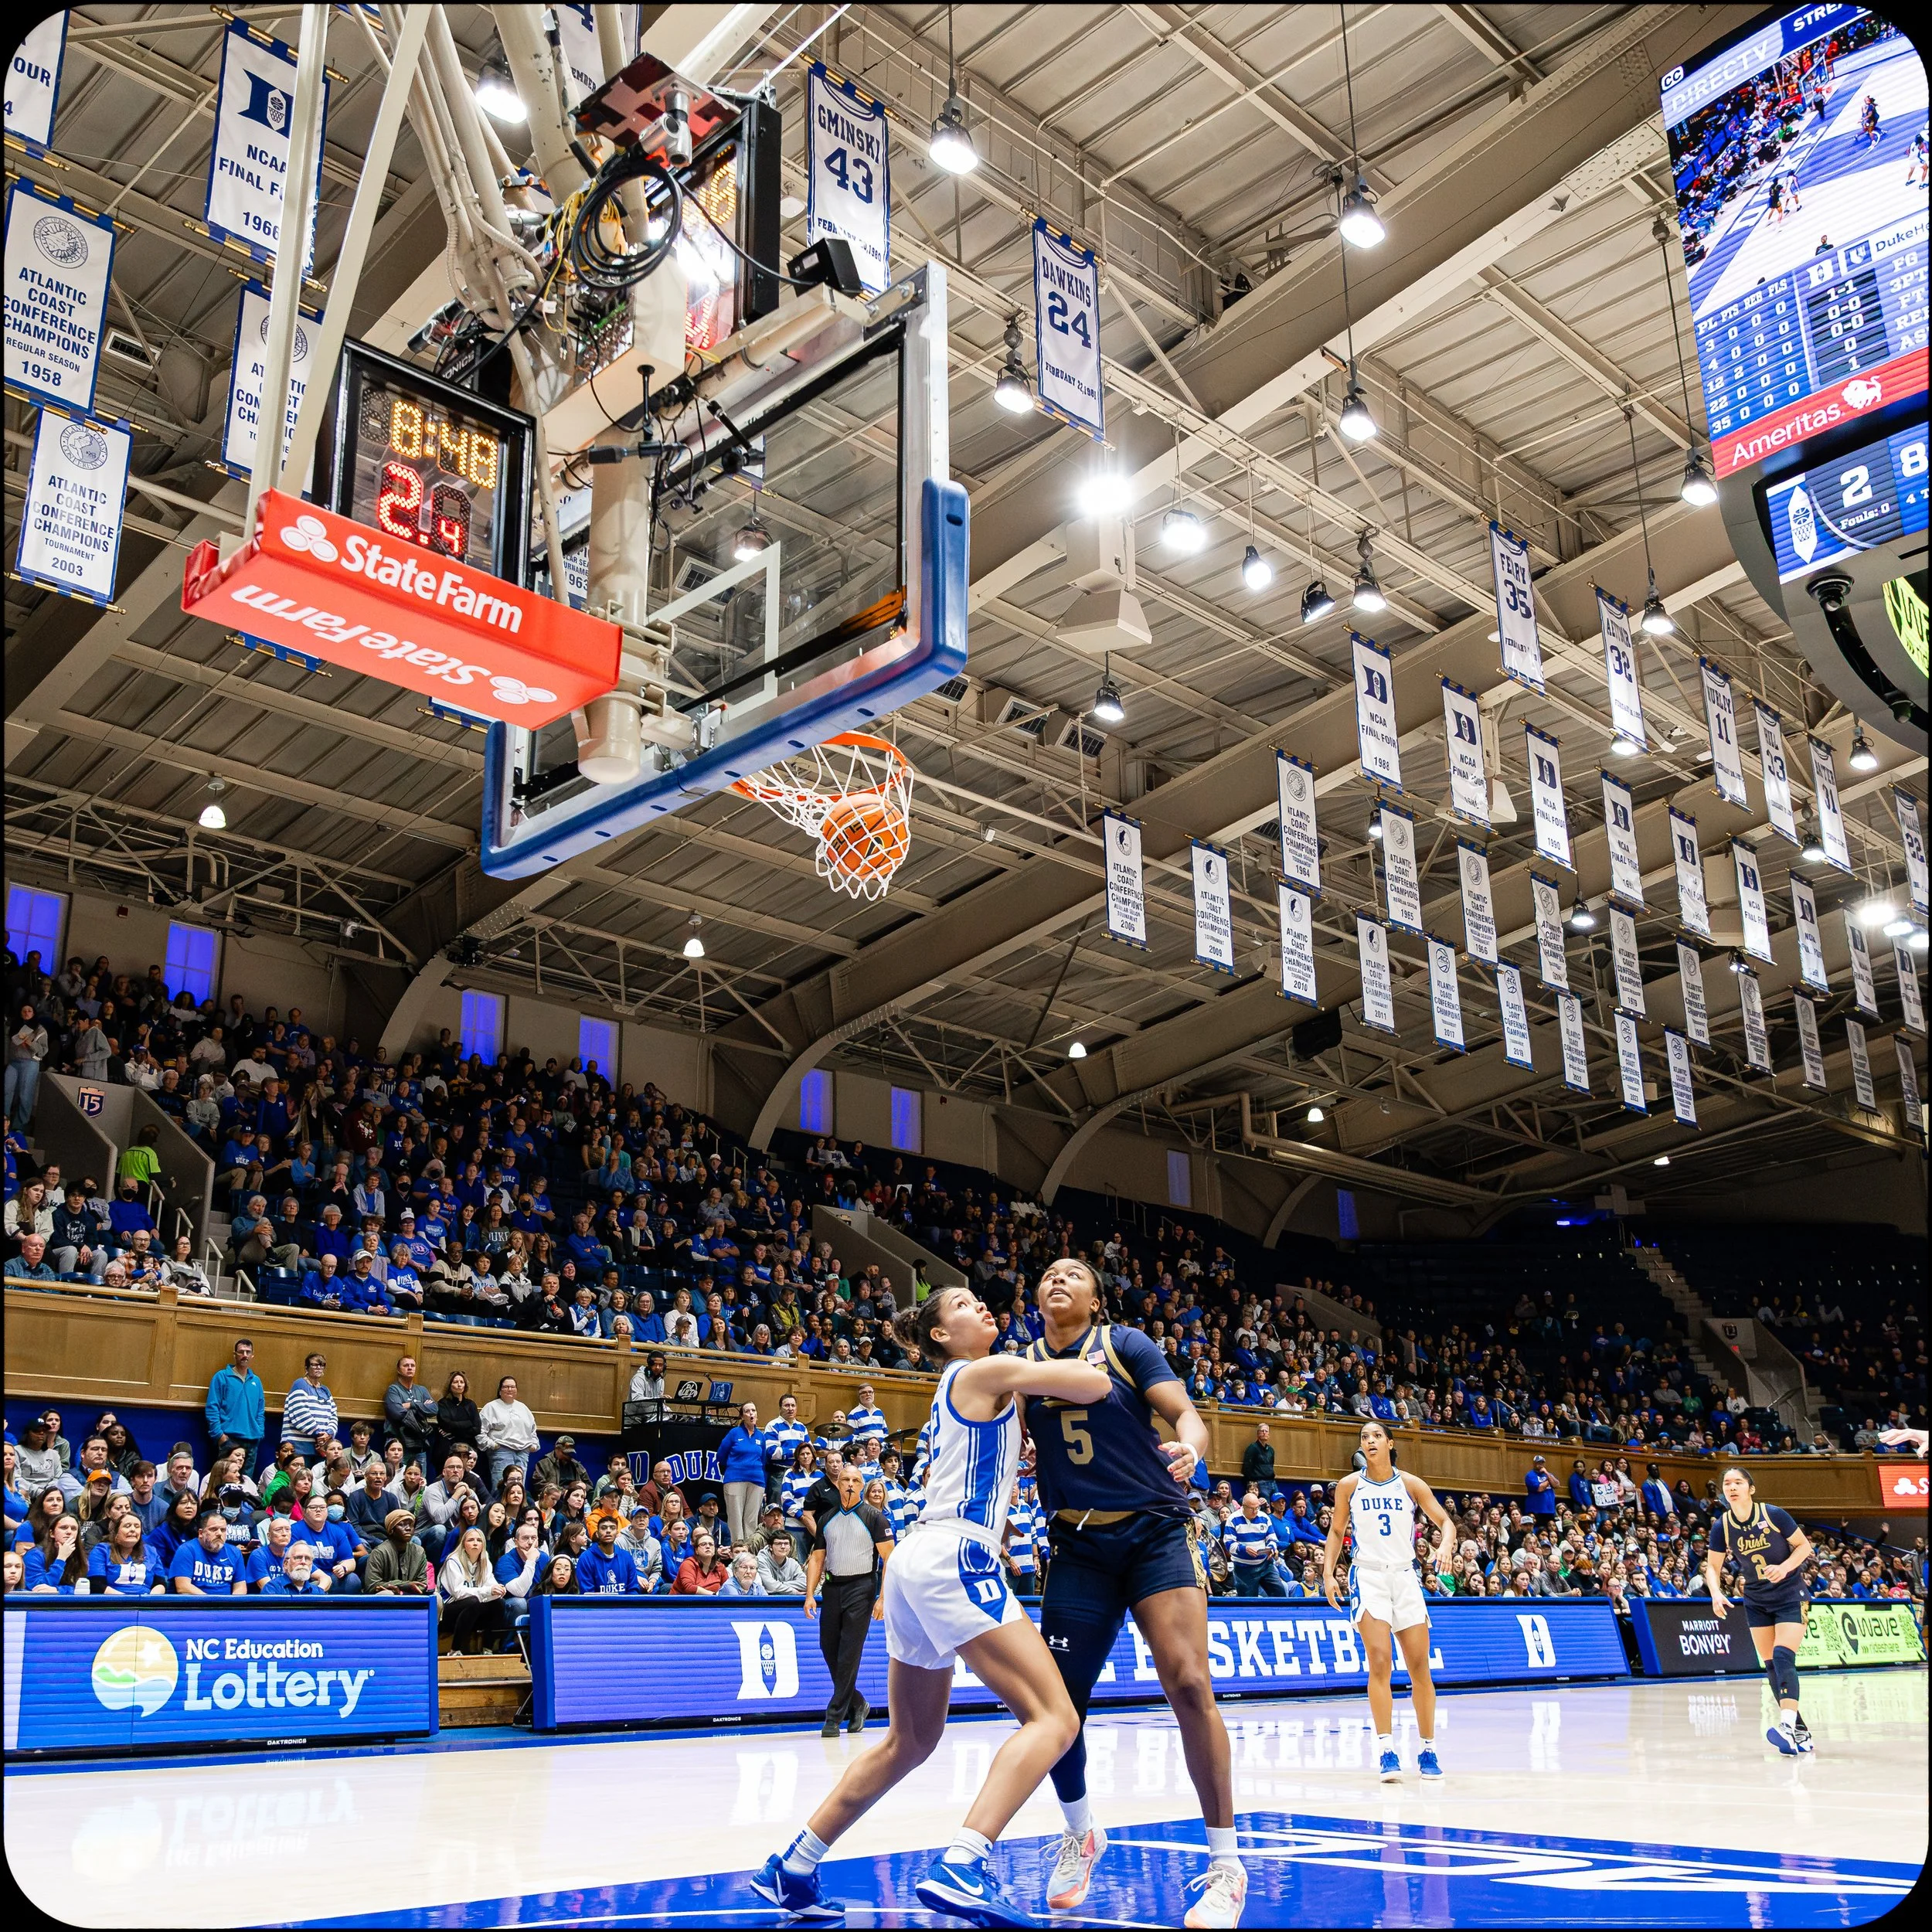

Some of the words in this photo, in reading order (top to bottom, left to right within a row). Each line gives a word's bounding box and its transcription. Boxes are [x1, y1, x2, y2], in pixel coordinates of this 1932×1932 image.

[13, 56, 51, 87] OUR
[1664, 70, 1682, 87] CC
[1672, 39, 1767, 111] DIRECTV
[818, 104, 880, 164] GMINSKI
[219, 158, 264, 192] FINAL
[824, 147, 873, 204] 43
[1892, 252, 1918, 272] FG
[19, 267, 87, 305] ATLANTIC
[1042, 256, 1091, 308] DAWKINS
[1889, 266, 1928, 293] 3PT
[1827, 280, 1856, 302] 1-1
[1899, 287, 1925, 309] FT
[28, 287, 76, 318] COAST
[1827, 295, 1861, 320] 0-0
[4, 294, 96, 345] CONFERENCE
[1048, 291, 1091, 349] 24
[1705, 339, 1715, 352] 3
[1727, 327, 1738, 339] 0
[1751, 314, 1761, 327] 0
[1775, 301, 1787, 315] 0
[1830, 313, 1864, 338] 0-0
[4, 314, 90, 359] CHAMPIONS
[1708, 358, 1719, 371] 4
[1731, 346, 1741, 359] 0
[1754, 333, 1764, 346] 0
[1778, 321, 1790, 335] 0
[1844, 337, 1857, 352] 0
[6, 338, 46, 360] REGULAR
[48, 351, 81, 373] SEASON
[1849, 356, 1861, 372] 1
[21, 360, 63, 386] 1958
[1046, 362, 1076, 386] FEBRUARY
[1706, 376, 1725, 394] 12
[1733, 366, 1744, 380] 2
[1757, 353, 1767, 367] 0
[1781, 341, 1793, 355] 0
[1709, 396, 1729, 413] 22
[1736, 386, 1747, 400] 0
[1760, 373, 1770, 387] 0
[1785, 361, 1796, 376] 0
[1712, 416, 1731, 434] 35
[1740, 406, 1750, 420] 0
[1764, 393, 1774, 408] 0
[1788, 381, 1800, 396] 0
[390, 400, 497, 490] 8:48
[1731, 403, 1841, 467] Ameritas
[1900, 442, 1929, 478] 8
[48, 475, 107, 505] ATLANTIC
[1839, 465, 1873, 509] 2
[56, 493, 97, 516] COAST
[32, 502, 114, 539] CONFERENCE
[1839, 508, 1879, 530] Fouls:
[1881, 502, 1890, 514] 0
[33, 518, 110, 553] CHAMPIONS
[44, 538, 95, 562] TOURNAMENT
[51, 556, 83, 577] 2003
[1504, 579, 1532, 619] 35
[1611, 645, 1633, 683] 32
[1369, 712, 1387, 728] NCAA
[1716, 713, 1731, 745] 11
[1362, 724, 1380, 741] FINAL
[1373, 756, 1390, 771] 1988
[1459, 753, 1477, 768] NCAA
[1766, 749, 1786, 782] 33
[1821, 784, 1838, 815] 31
[1287, 806, 1311, 823] ATLANTIC
[1291, 818, 1308, 832] COAST
[1536, 808, 1551, 823] FINAL
[1284, 825, 1317, 848] CONFERENCE
[1285, 837, 1316, 858] CHAMPIONS
[1547, 837, 1561, 851] 1990
[1905, 832, 1925, 863] 22
[1113, 862, 1138, 879] ATLANTIC
[1295, 865, 1310, 878] 1964
[1390, 853, 1412, 869] ATLANTIC
[1117, 874, 1134, 888] COAST
[1394, 866, 1410, 879] COAST
[1109, 881, 1143, 901] CONFERENCE
[1111, 893, 1143, 911] CHAMPIONS
[1200, 890, 1225, 906] ATLANTIC
[1196, 909, 1230, 928] CONFERENCE
[1206, 901, 1222, 915] COAST
[1198, 920, 1230, 938] CHAMPIONS
[1286, 928, 1308, 944] ATLANTIC
[1209, 944, 1223, 957] 2009
[1283, 947, 1313, 964] CONFERENCE
[1284, 956, 1313, 974] CHAMPIONS
[1294, 980, 1308, 992] 2010
[1375, 1010, 1386, 1020] 2011
[1444, 1028, 1455, 1039] 2017
[82, 1094, 101, 1112] 15
[488, 1231, 509, 1242] UKE
[1061, 1410, 1094, 1465] 5
[665, 1451, 724, 1485] DUK
[1361, 1498, 1403, 1512] DUKE
[1379, 1514, 1391, 1536] 3
[1737, 1534, 1770, 1554] Irish
[195, 1560, 233, 1581] DUKE
[600, 1583, 626, 1594] DUKE
[1682, 1620, 1719, 1631] MARRIOTT
[185, 1638, 220, 1660] NC
[225, 1638, 323, 1659] Education
[1679, 1634, 1730, 1656] BONVOY
[184, 1662, 369, 1718] Lottery
